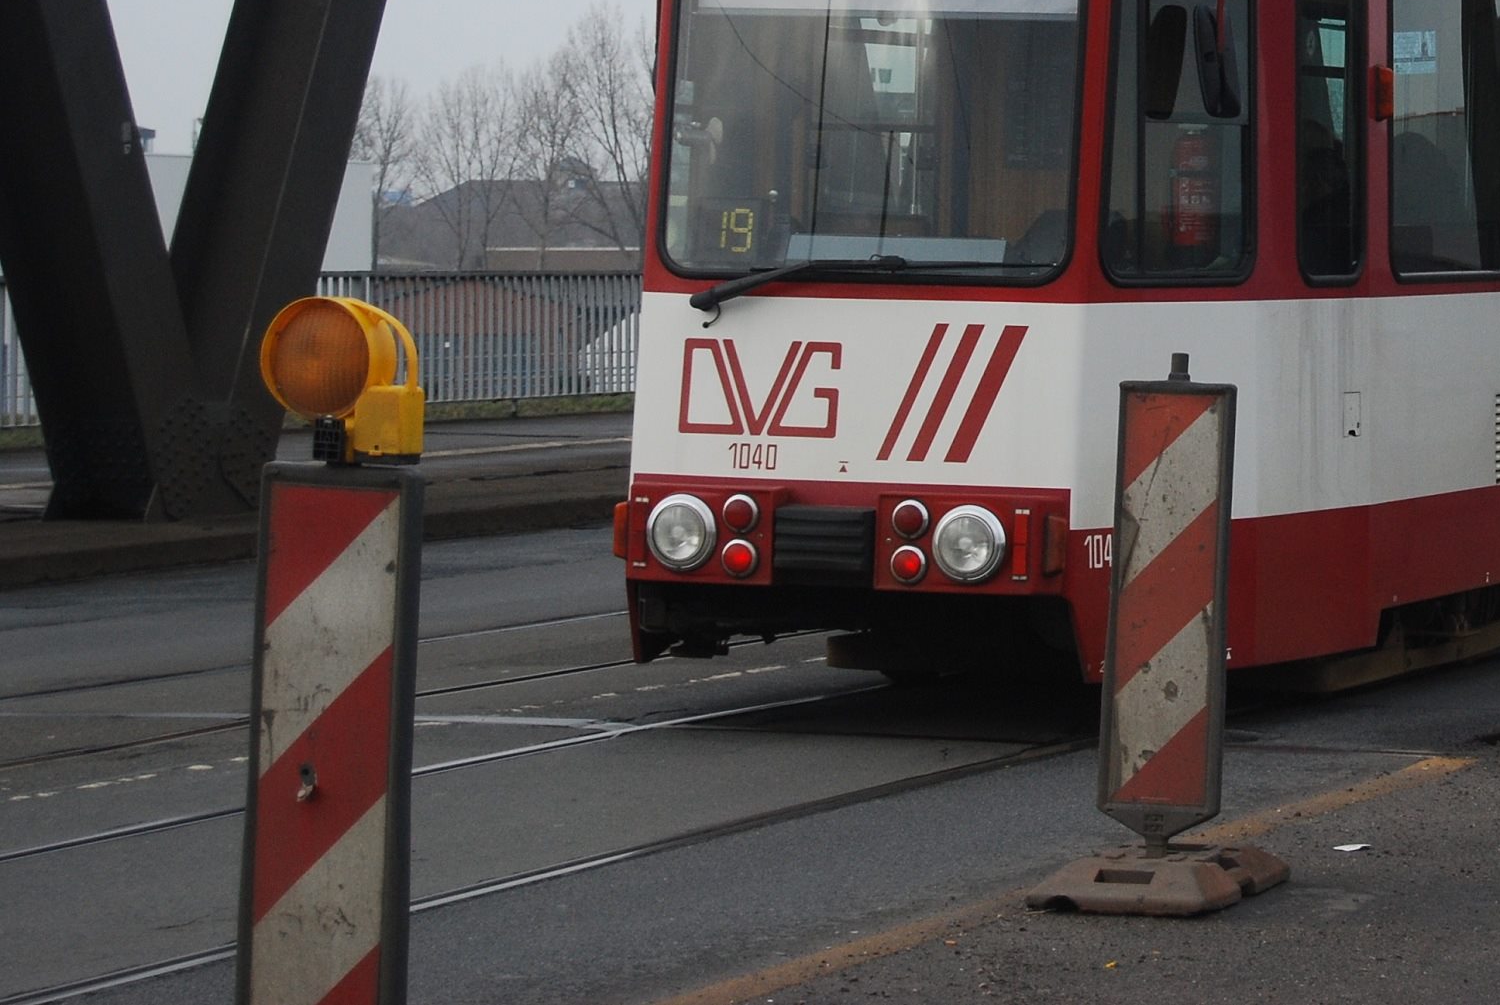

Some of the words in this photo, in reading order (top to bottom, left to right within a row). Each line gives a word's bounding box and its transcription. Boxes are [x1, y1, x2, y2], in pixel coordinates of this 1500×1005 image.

[720, 207, 755, 253] 19
[678, 338, 843, 439] DVG
[728, 442, 779, 471] 1040
